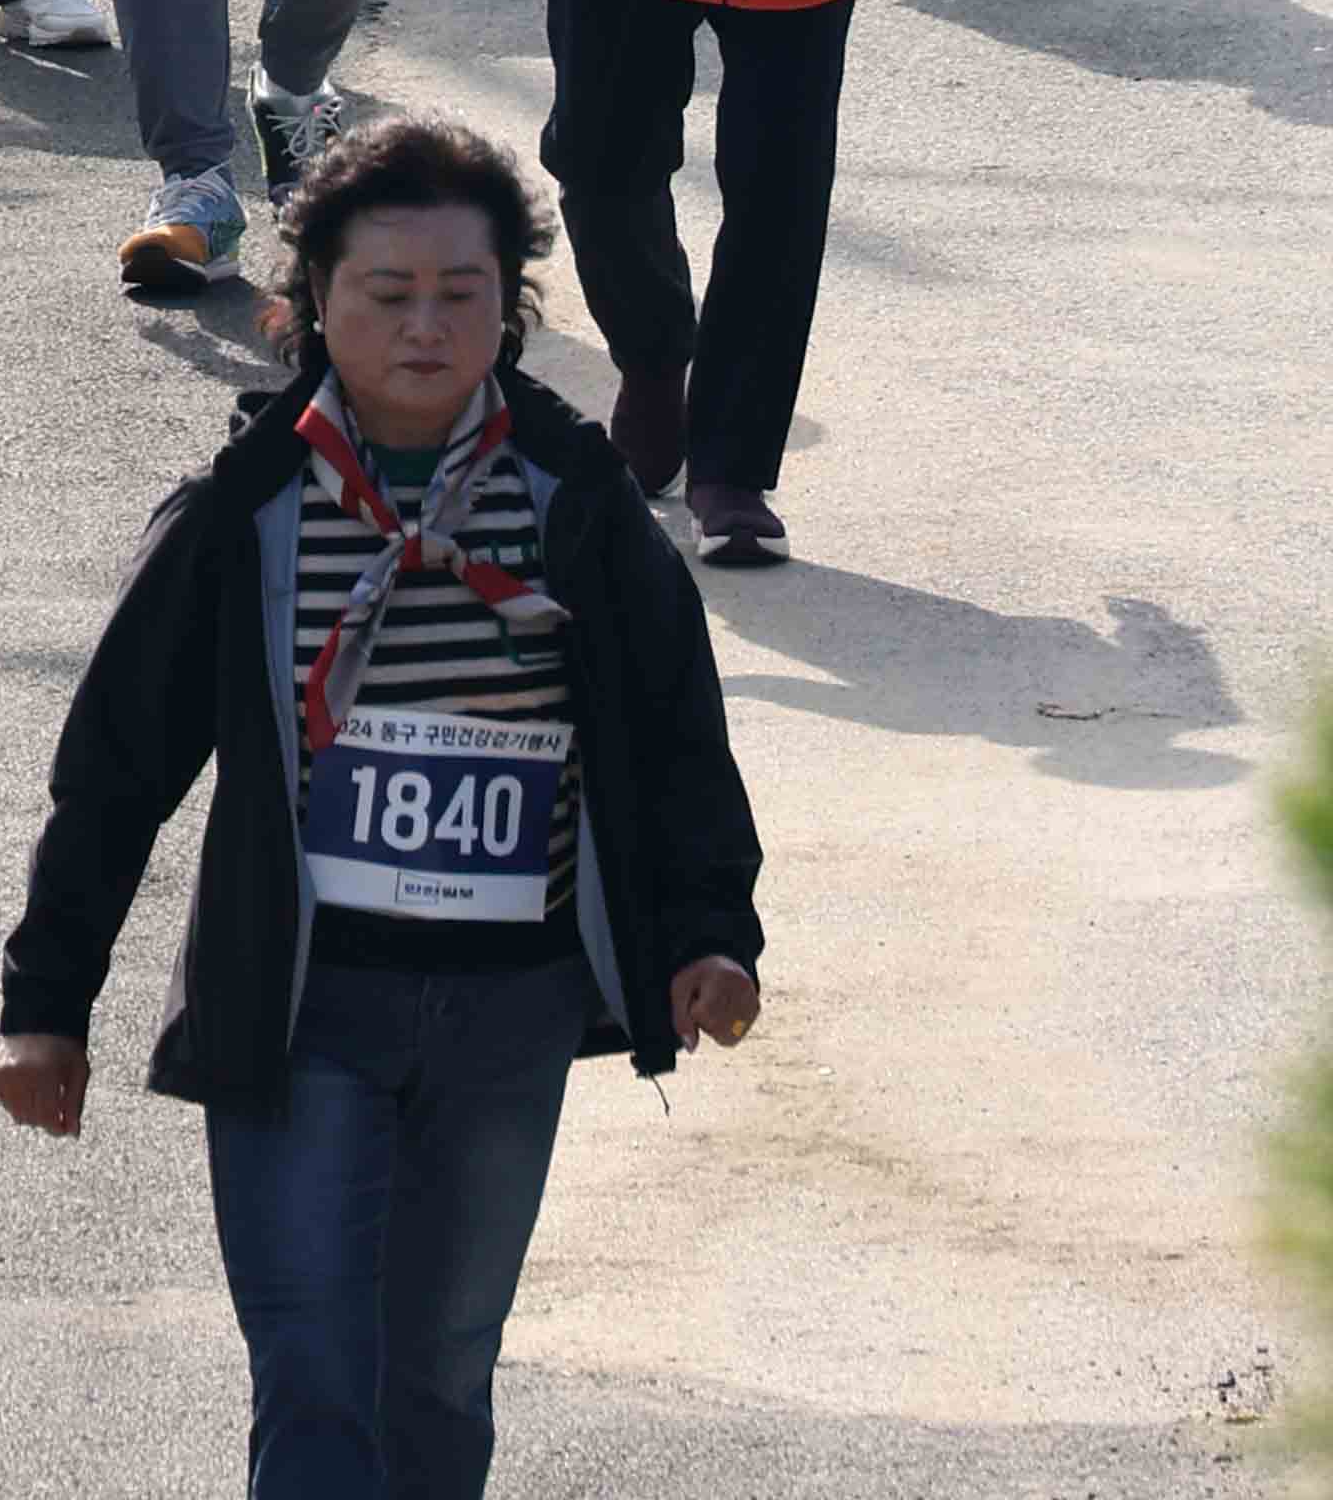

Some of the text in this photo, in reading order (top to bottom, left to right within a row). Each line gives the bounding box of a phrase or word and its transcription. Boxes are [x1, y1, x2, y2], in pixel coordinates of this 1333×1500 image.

[341, 717, 561, 753] 024 동구 구민건강걷기행사
[351, 765, 523, 858] 1840
